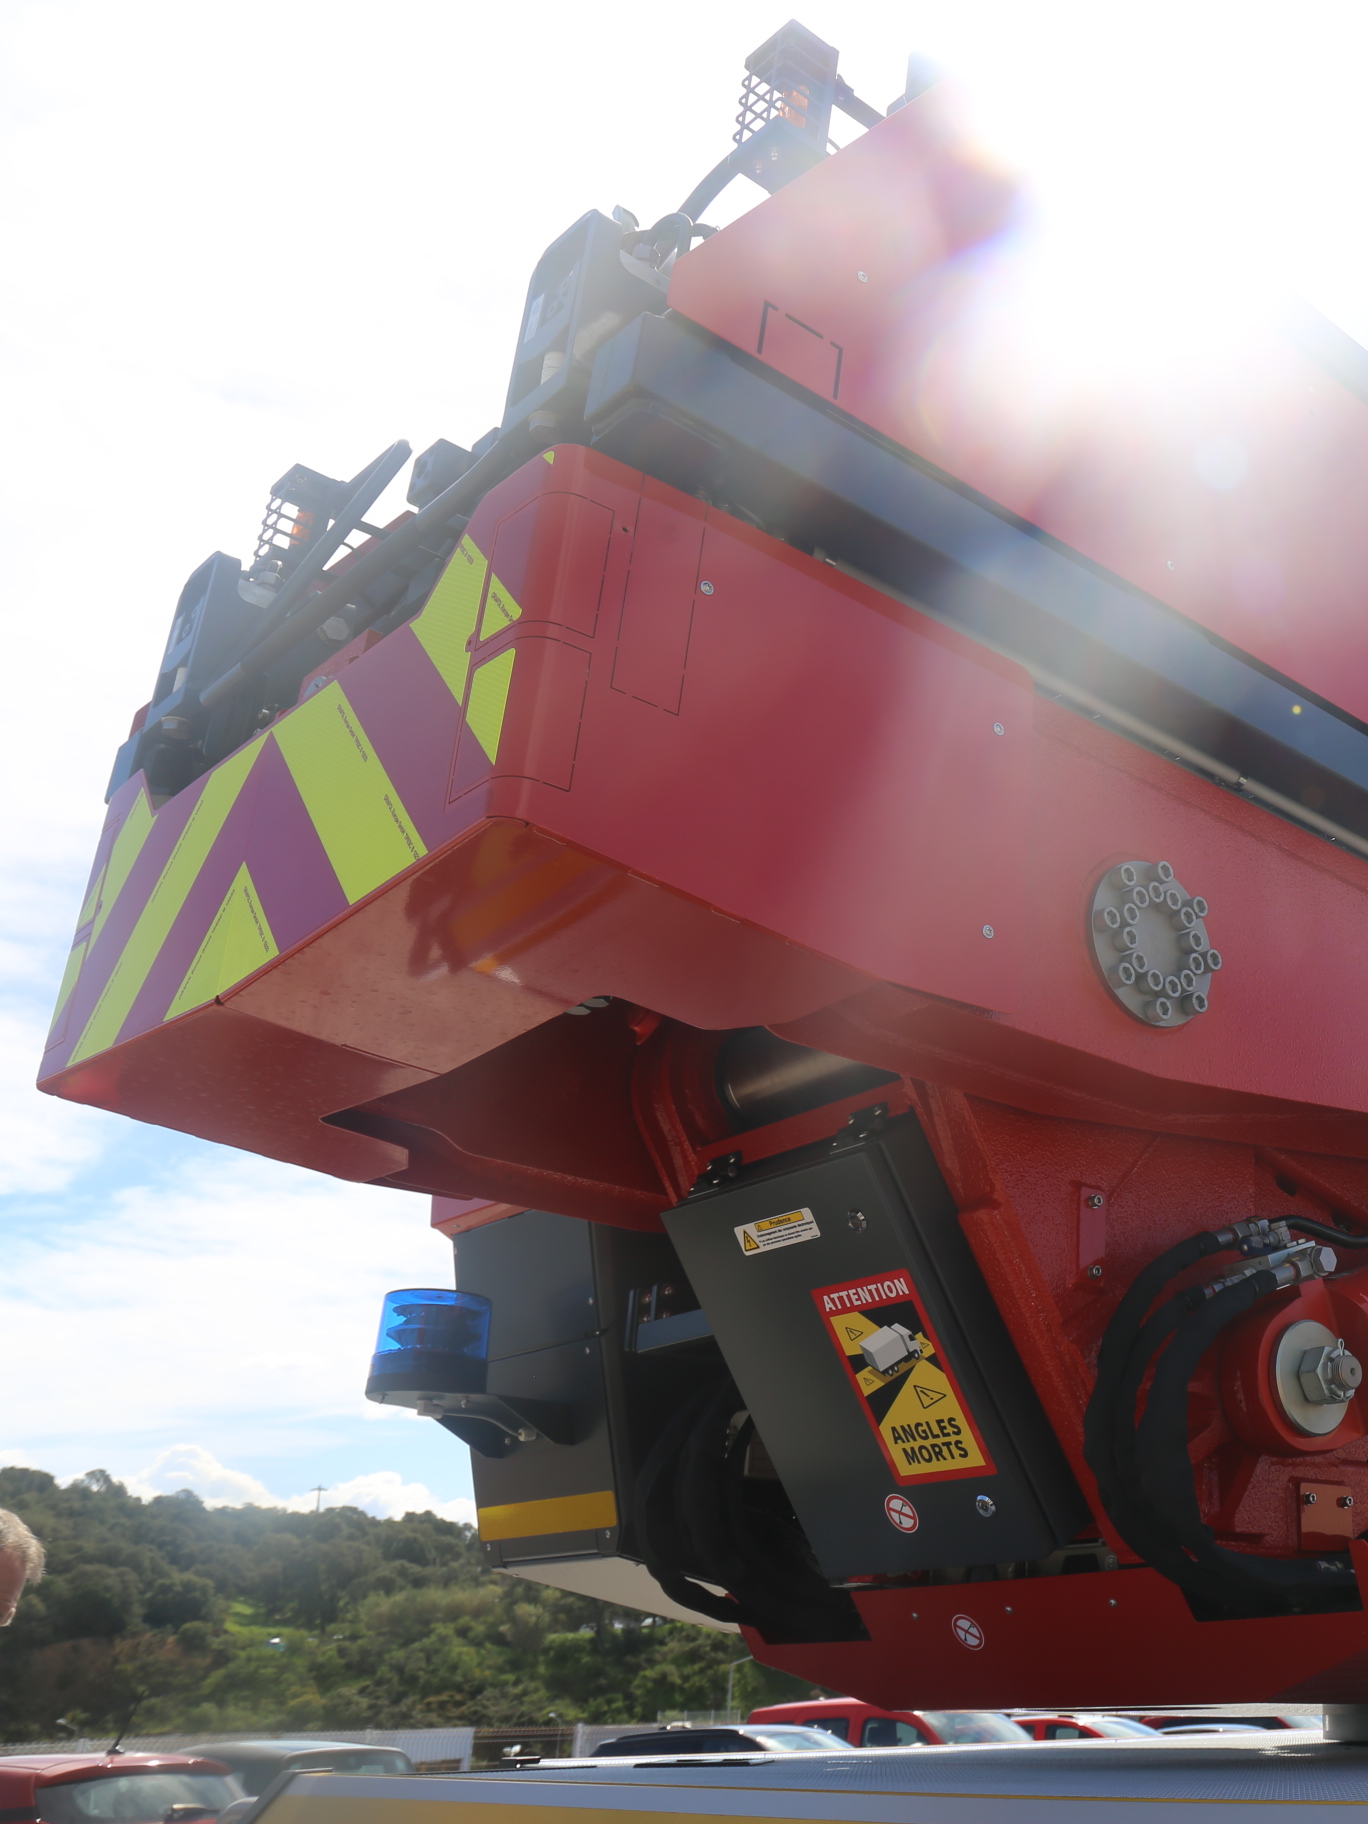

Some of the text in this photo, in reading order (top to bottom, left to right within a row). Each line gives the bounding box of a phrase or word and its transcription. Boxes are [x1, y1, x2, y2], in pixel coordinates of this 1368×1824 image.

[769, 1217, 792, 1227] Prudence
[823, 1278, 910, 1312] ATTENTION
[890, 1416, 962, 1445] ANGLES
[901, 1439, 969, 1466] MORTS
